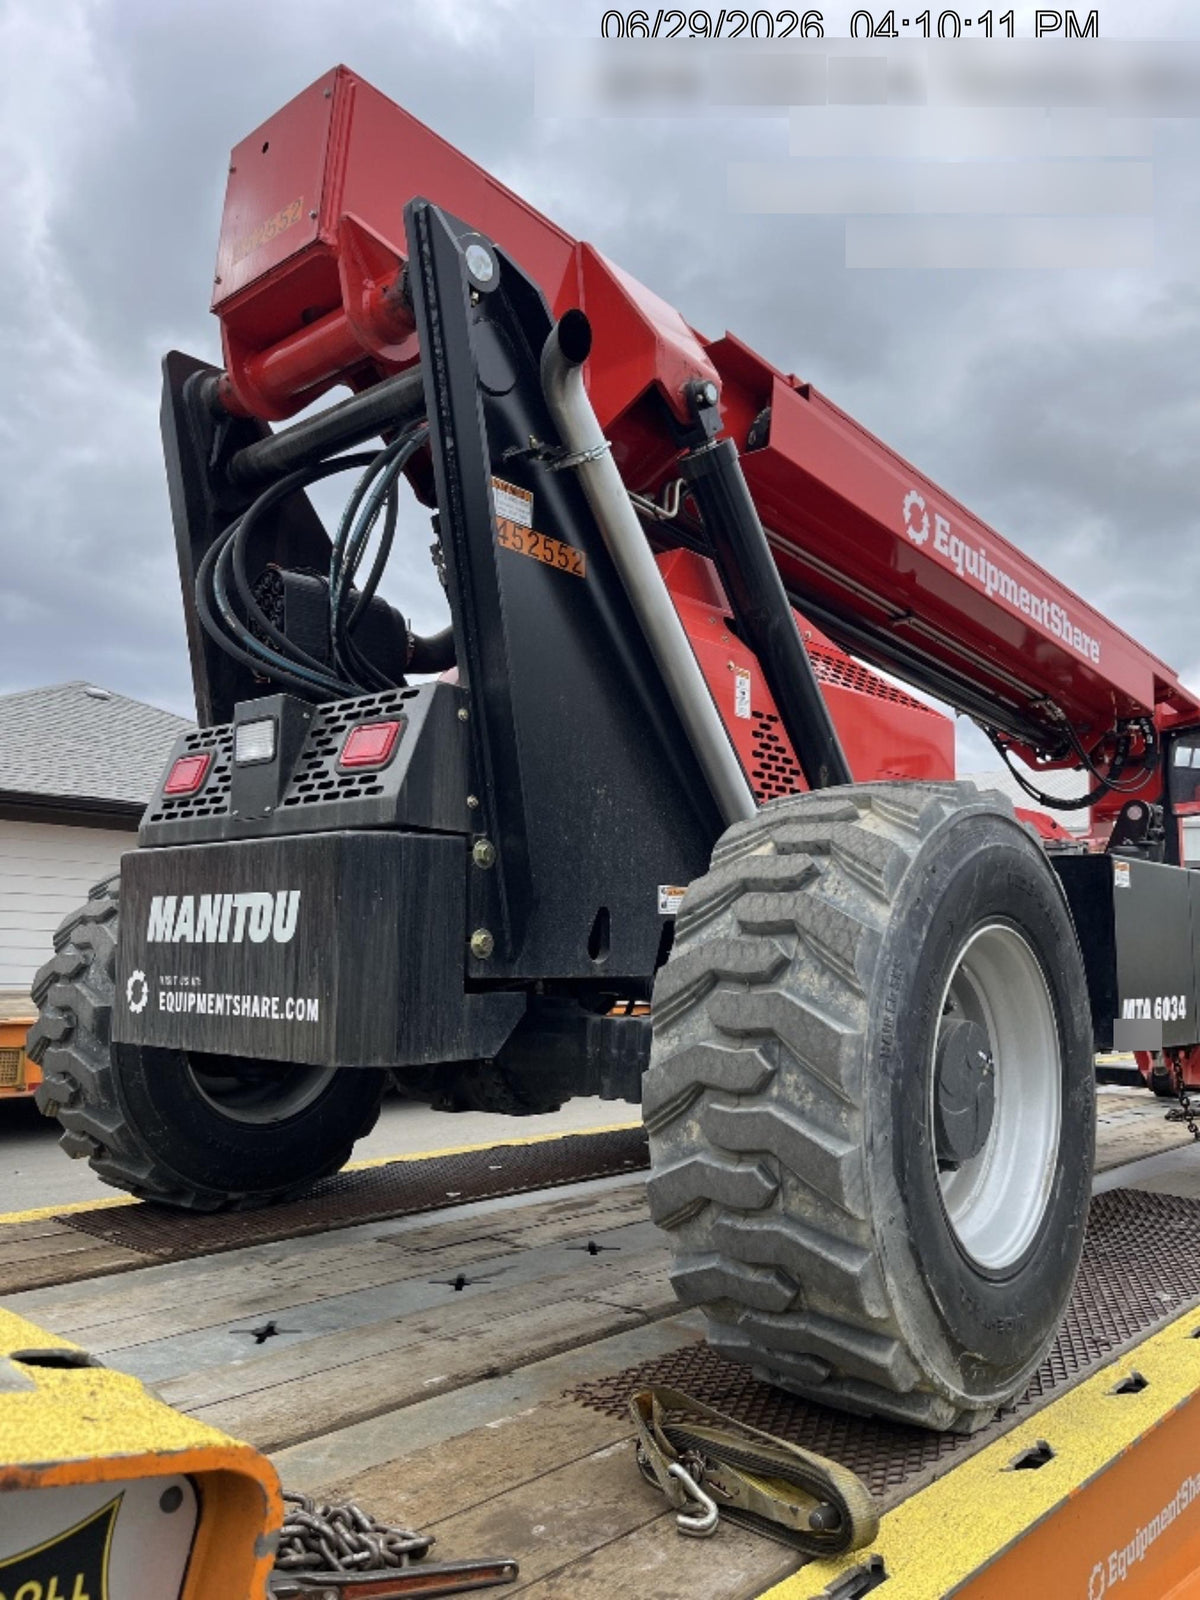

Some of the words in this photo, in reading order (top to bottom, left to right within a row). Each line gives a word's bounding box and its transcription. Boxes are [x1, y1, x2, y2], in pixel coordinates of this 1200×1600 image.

[496, 520, 583, 575] 452552
[933, 512, 1100, 664] EquipmentShare
[146, 889, 301, 943] MANITOU
[158, 990, 320, 1023] EQUIPMENTSHARE.COM
[1122, 998, 1152, 1020] MTA
[1154, 994, 1187, 1021] 6034
